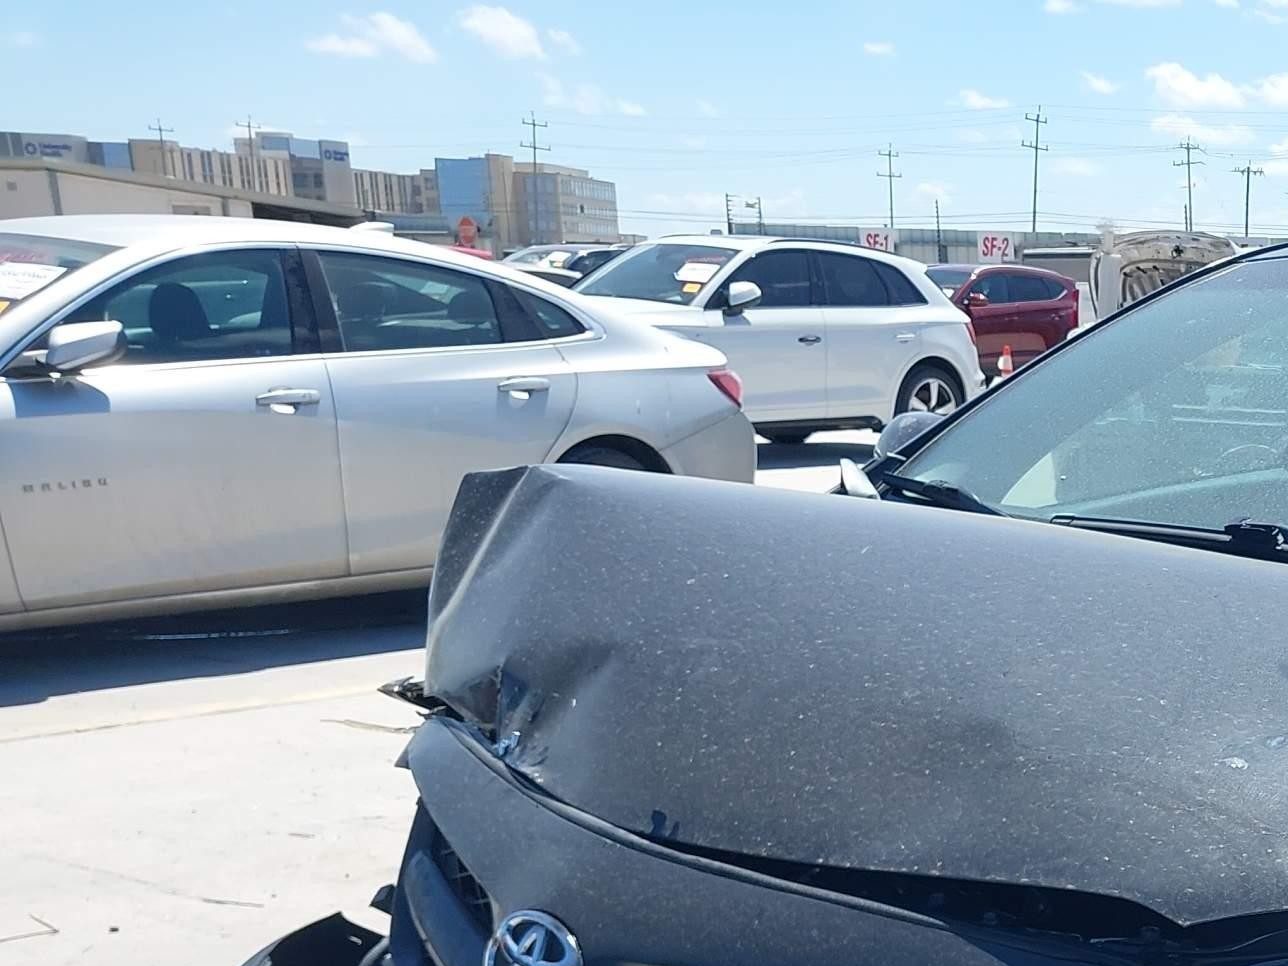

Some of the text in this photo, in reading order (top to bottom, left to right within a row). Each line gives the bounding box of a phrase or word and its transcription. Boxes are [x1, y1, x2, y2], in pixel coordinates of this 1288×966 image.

[866, 233, 889, 251] SF-1
[982, 236, 1009, 257] SF-2
[22, 478, 108, 493] MALIBU
